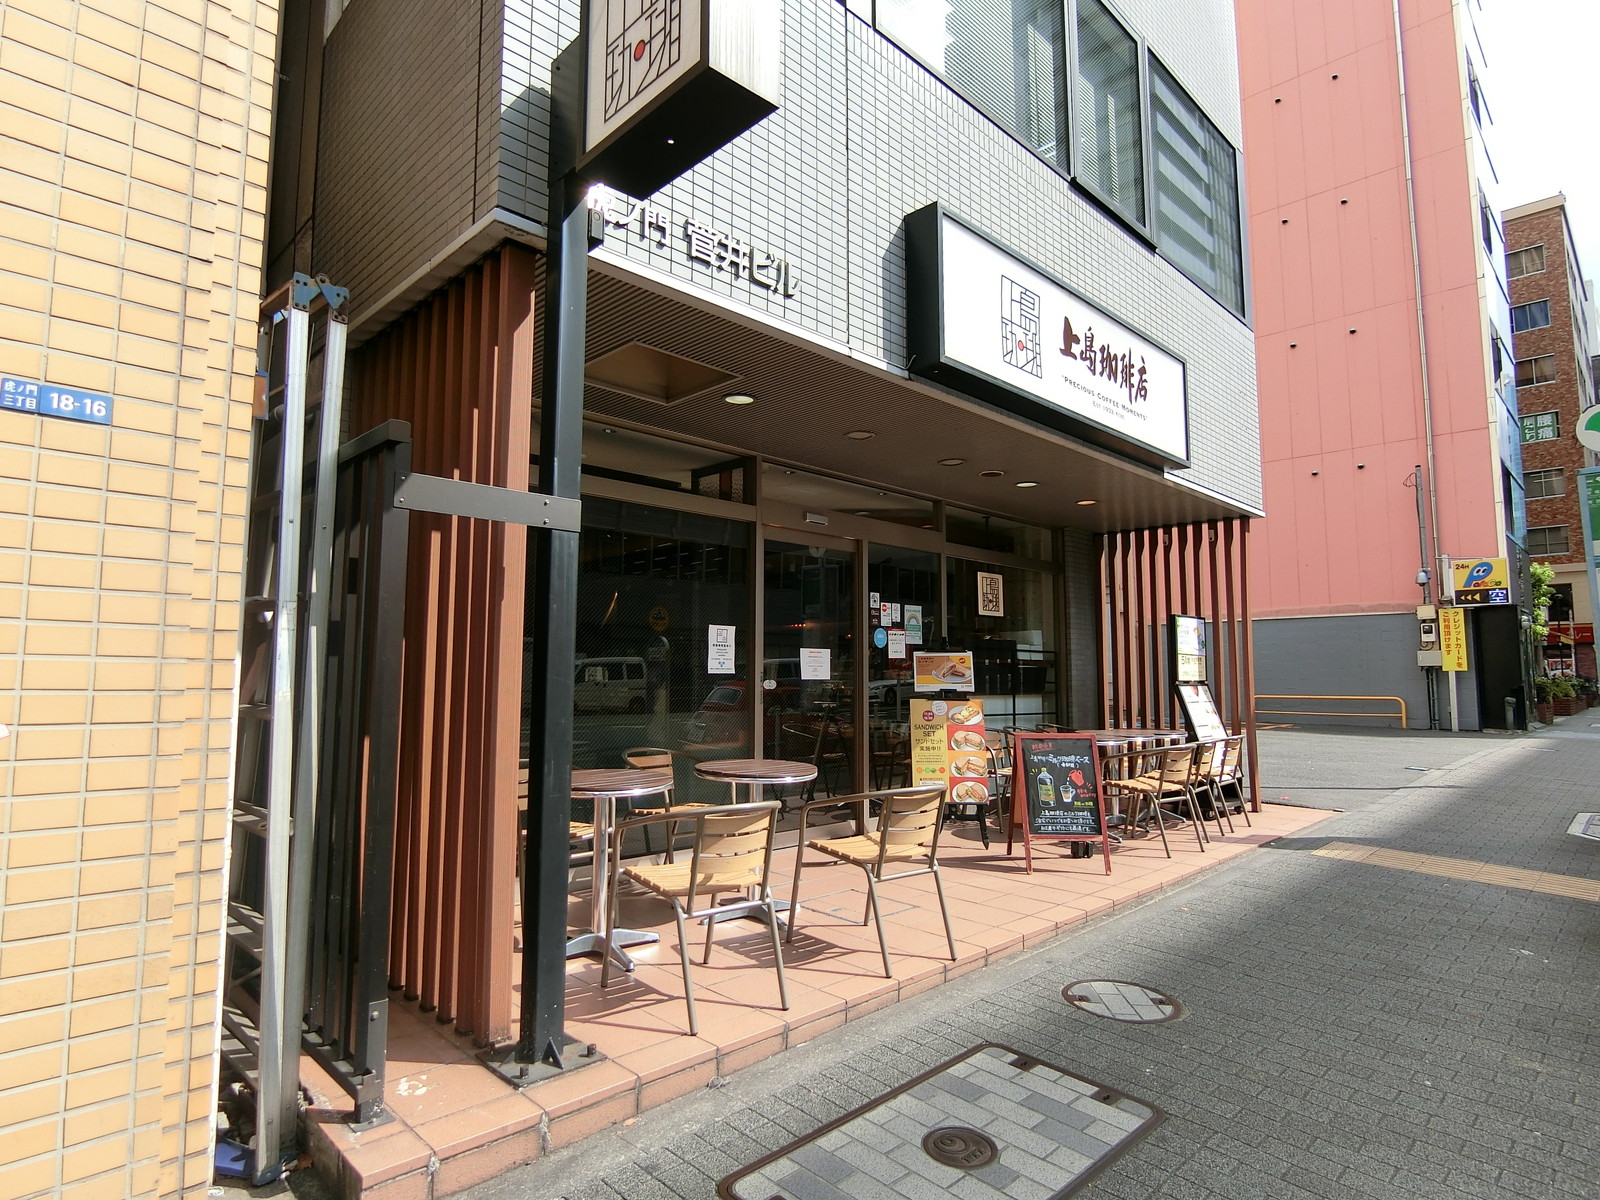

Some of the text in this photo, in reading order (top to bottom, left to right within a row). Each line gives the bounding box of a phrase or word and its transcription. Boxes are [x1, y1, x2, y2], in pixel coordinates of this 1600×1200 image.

[685, 216, 801, 298] 菅井ビル
[1059, 315, 1149, 405] 上島珈琲店
[4, 380, 38, 396] 虎ノ門
[3, 394, 37, 410] 三丁目
[49, 392, 107, 417] 18-16
[1537, 414, 1553, 439] 腰痛
[1488, 588, 1507, 603] 空
[1442, 611, 1452, 656] ご利用頂けます
[1453, 610, 1464, 669] クレジットカードを
[914, 723, 944, 731] SANDWICH
